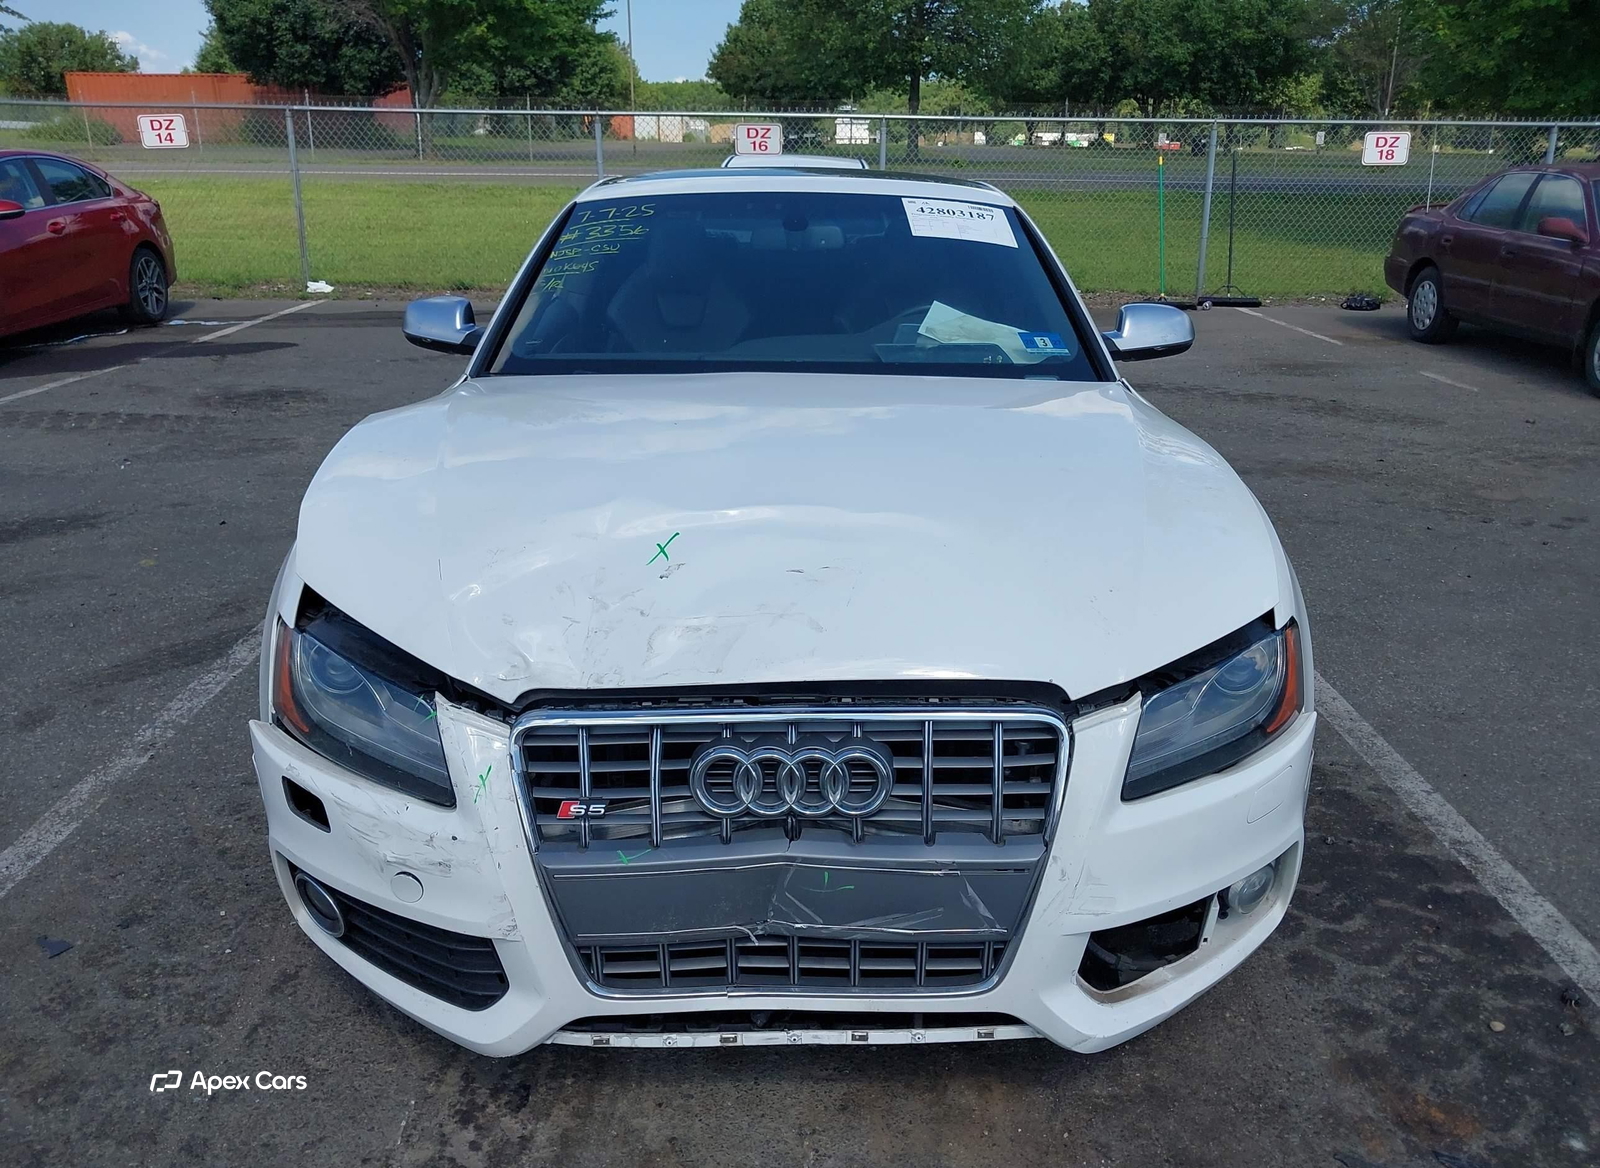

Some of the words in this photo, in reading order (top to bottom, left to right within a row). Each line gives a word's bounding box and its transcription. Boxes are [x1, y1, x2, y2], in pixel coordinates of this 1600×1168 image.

[150, 119, 176, 131] DZ
[155, 132, 174, 144] 14
[746, 127, 772, 140] DZ
[750, 140, 768, 152] 16
[1375, 136, 1400, 149] DZ
[1377, 149, 1395, 161] 18
[916, 205, 995, 222] 42803187
[1039, 337, 1048, 347] 3
[568, 804, 606, 816] S5
